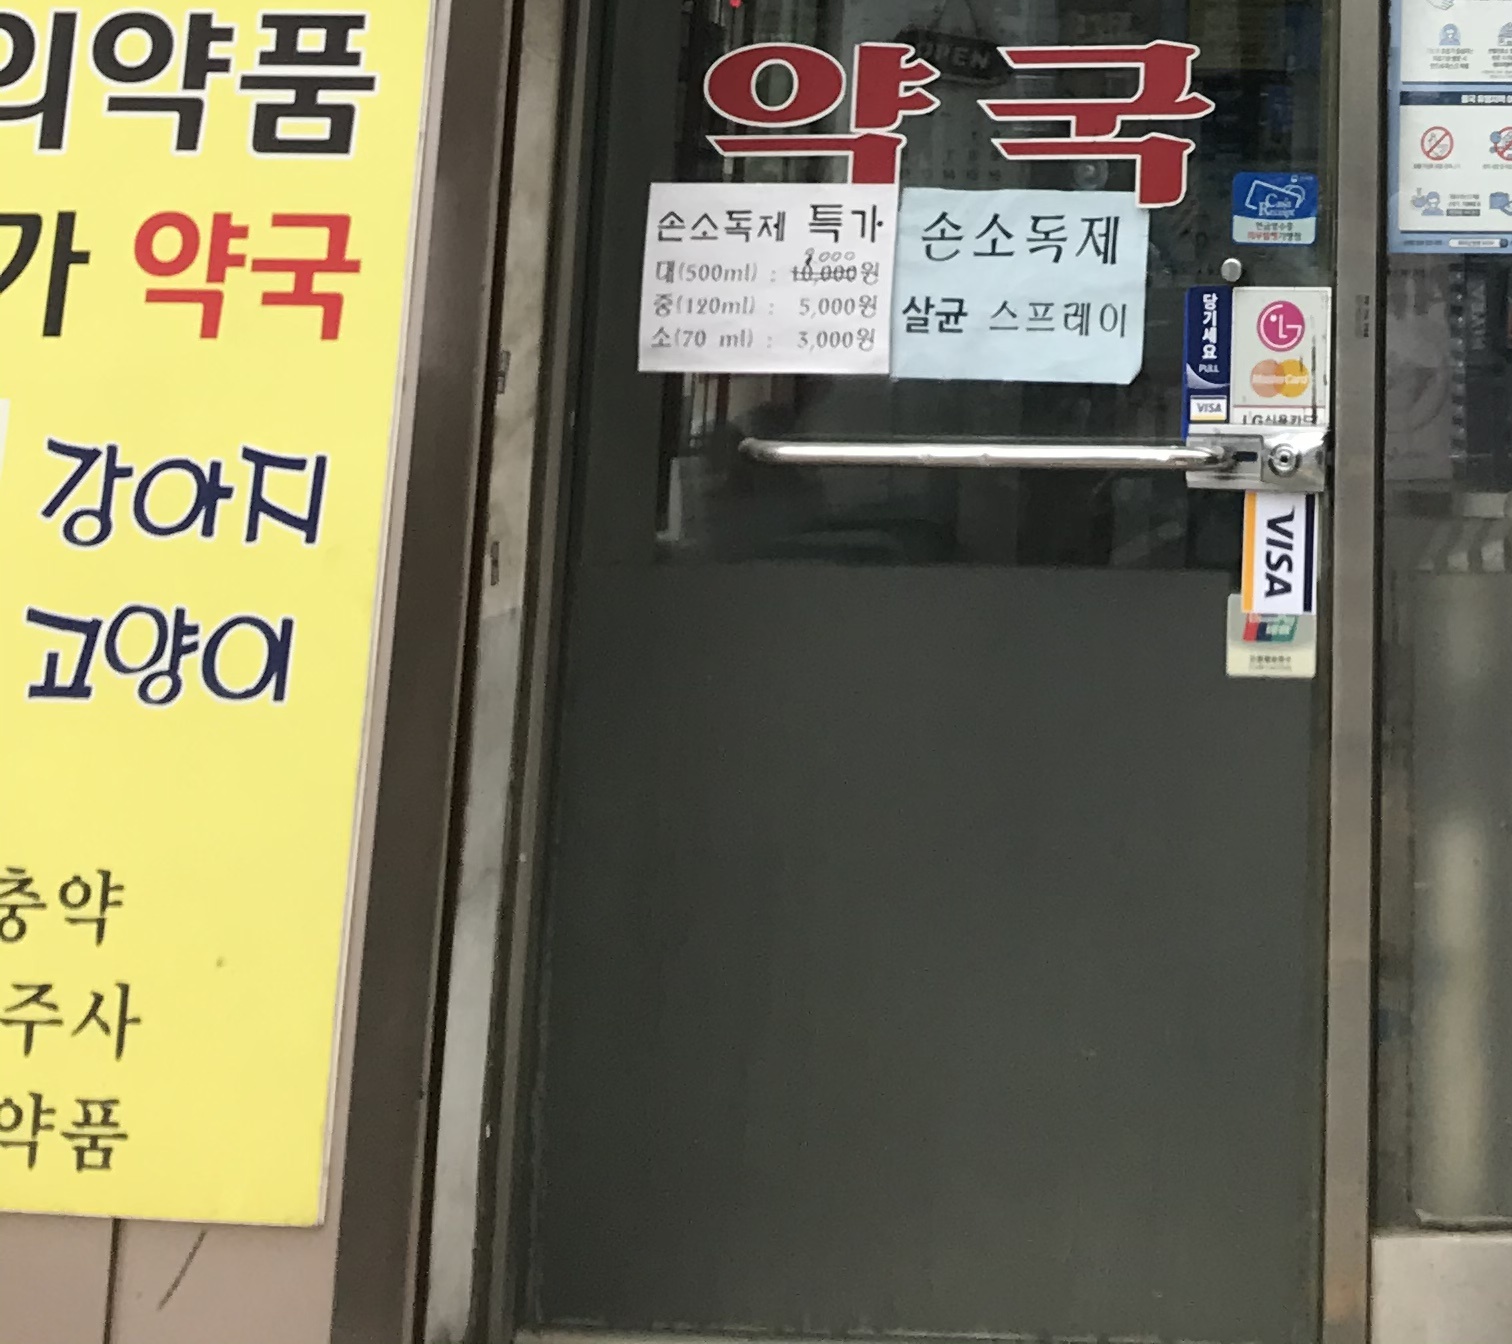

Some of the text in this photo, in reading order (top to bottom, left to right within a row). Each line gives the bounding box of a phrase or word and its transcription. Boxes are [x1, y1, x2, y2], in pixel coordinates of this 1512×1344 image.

[703, 39, 1216, 209] 약국
[656, 203, 884, 243] 손소독제 특가
[921, 211, 1120, 266] 손소독제
[134, 210, 361, 341] 약국
[653, 293, 755, 318] 중(120ml)
[799, 294, 878, 319] 5,000원
[797, 327, 876, 352] 3,000원
[902, 296, 1127, 338] 살균 스프레이
[1202, 292, 1218, 359] 당기세요
[1196, 402, 1222, 413] VISA
[41, 438, 327, 548] 강아지
[1265, 505, 1296, 598] VISA
[26, 604, 294, 706] 고양이
